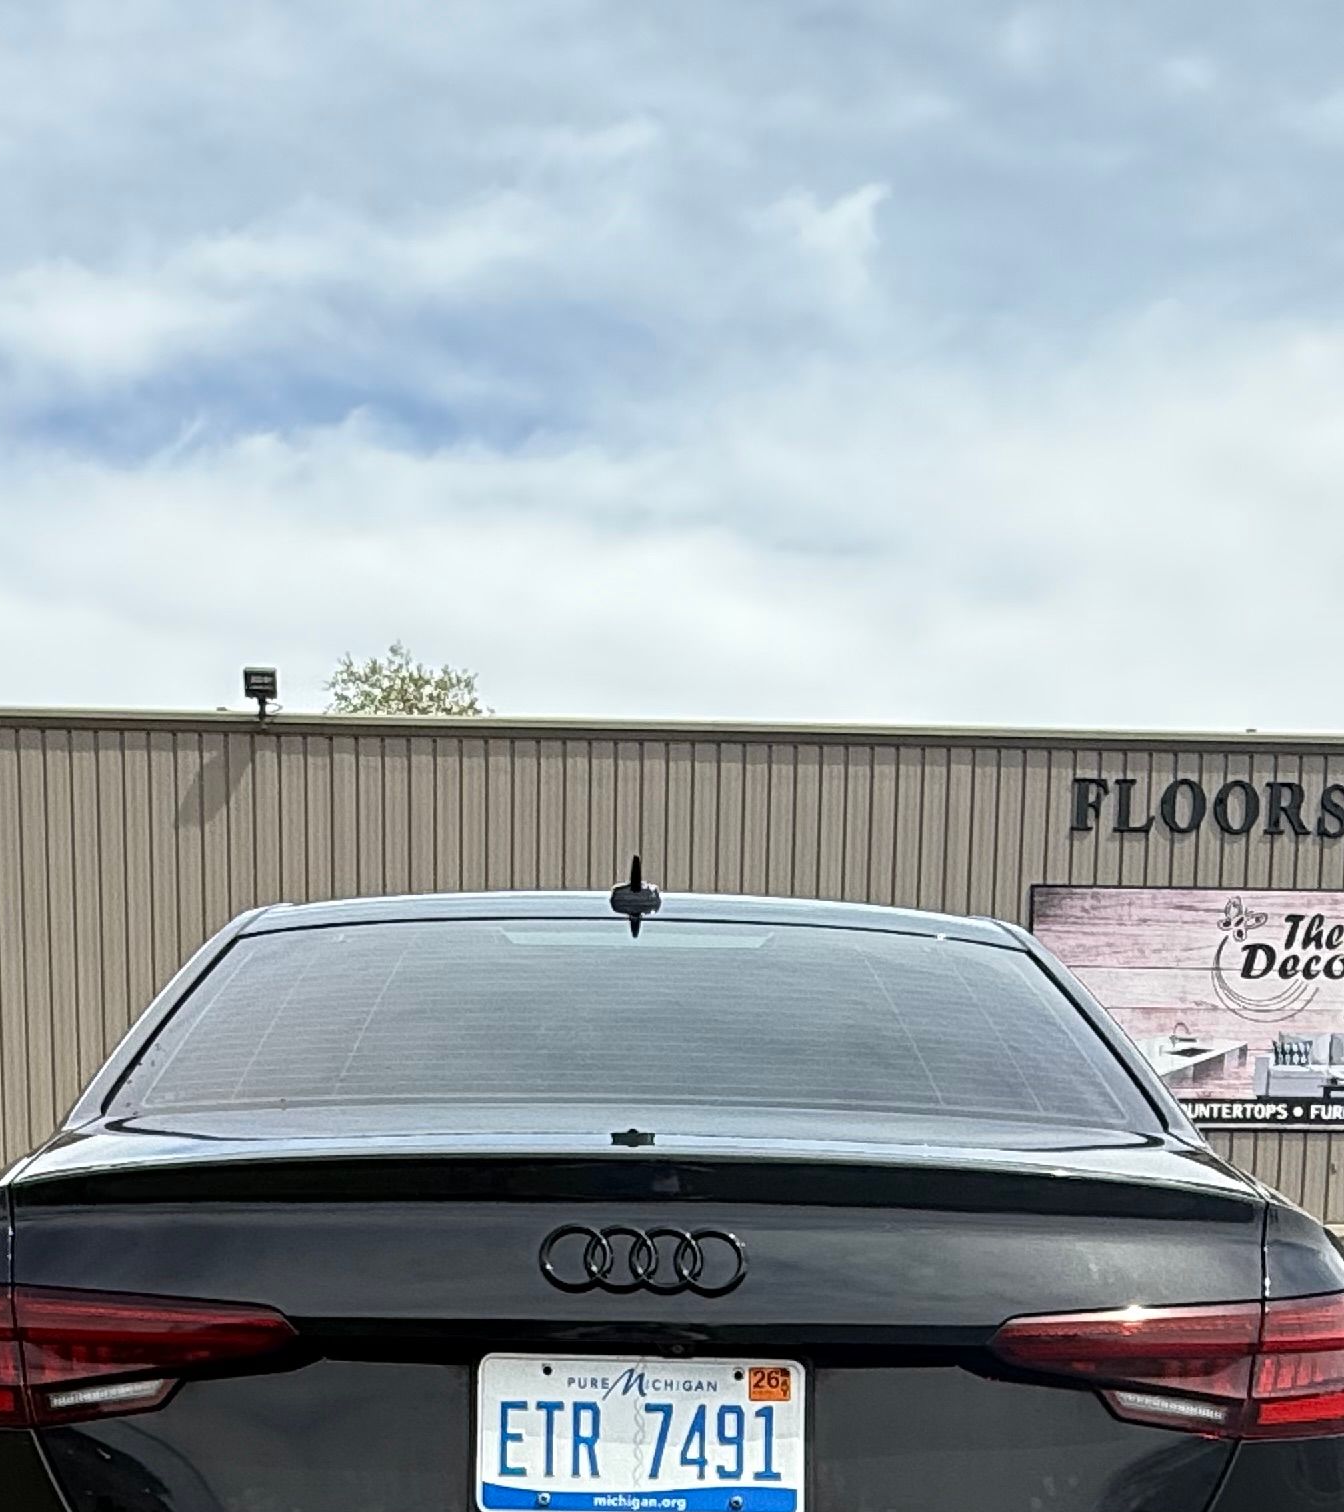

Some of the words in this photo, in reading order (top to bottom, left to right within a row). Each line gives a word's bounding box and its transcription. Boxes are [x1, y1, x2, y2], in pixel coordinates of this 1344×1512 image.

[1284, 914, 1344, 951] The
[567, 1377, 610, 1389] PURE
[602, 1368, 718, 1401] MICHIGAN
[753, 1370, 780, 1389] 26
[499, 1400, 600, 1478] ETR
[645, 1403, 782, 1481] 7491
[593, 1494, 686, 1511] michigan.org
